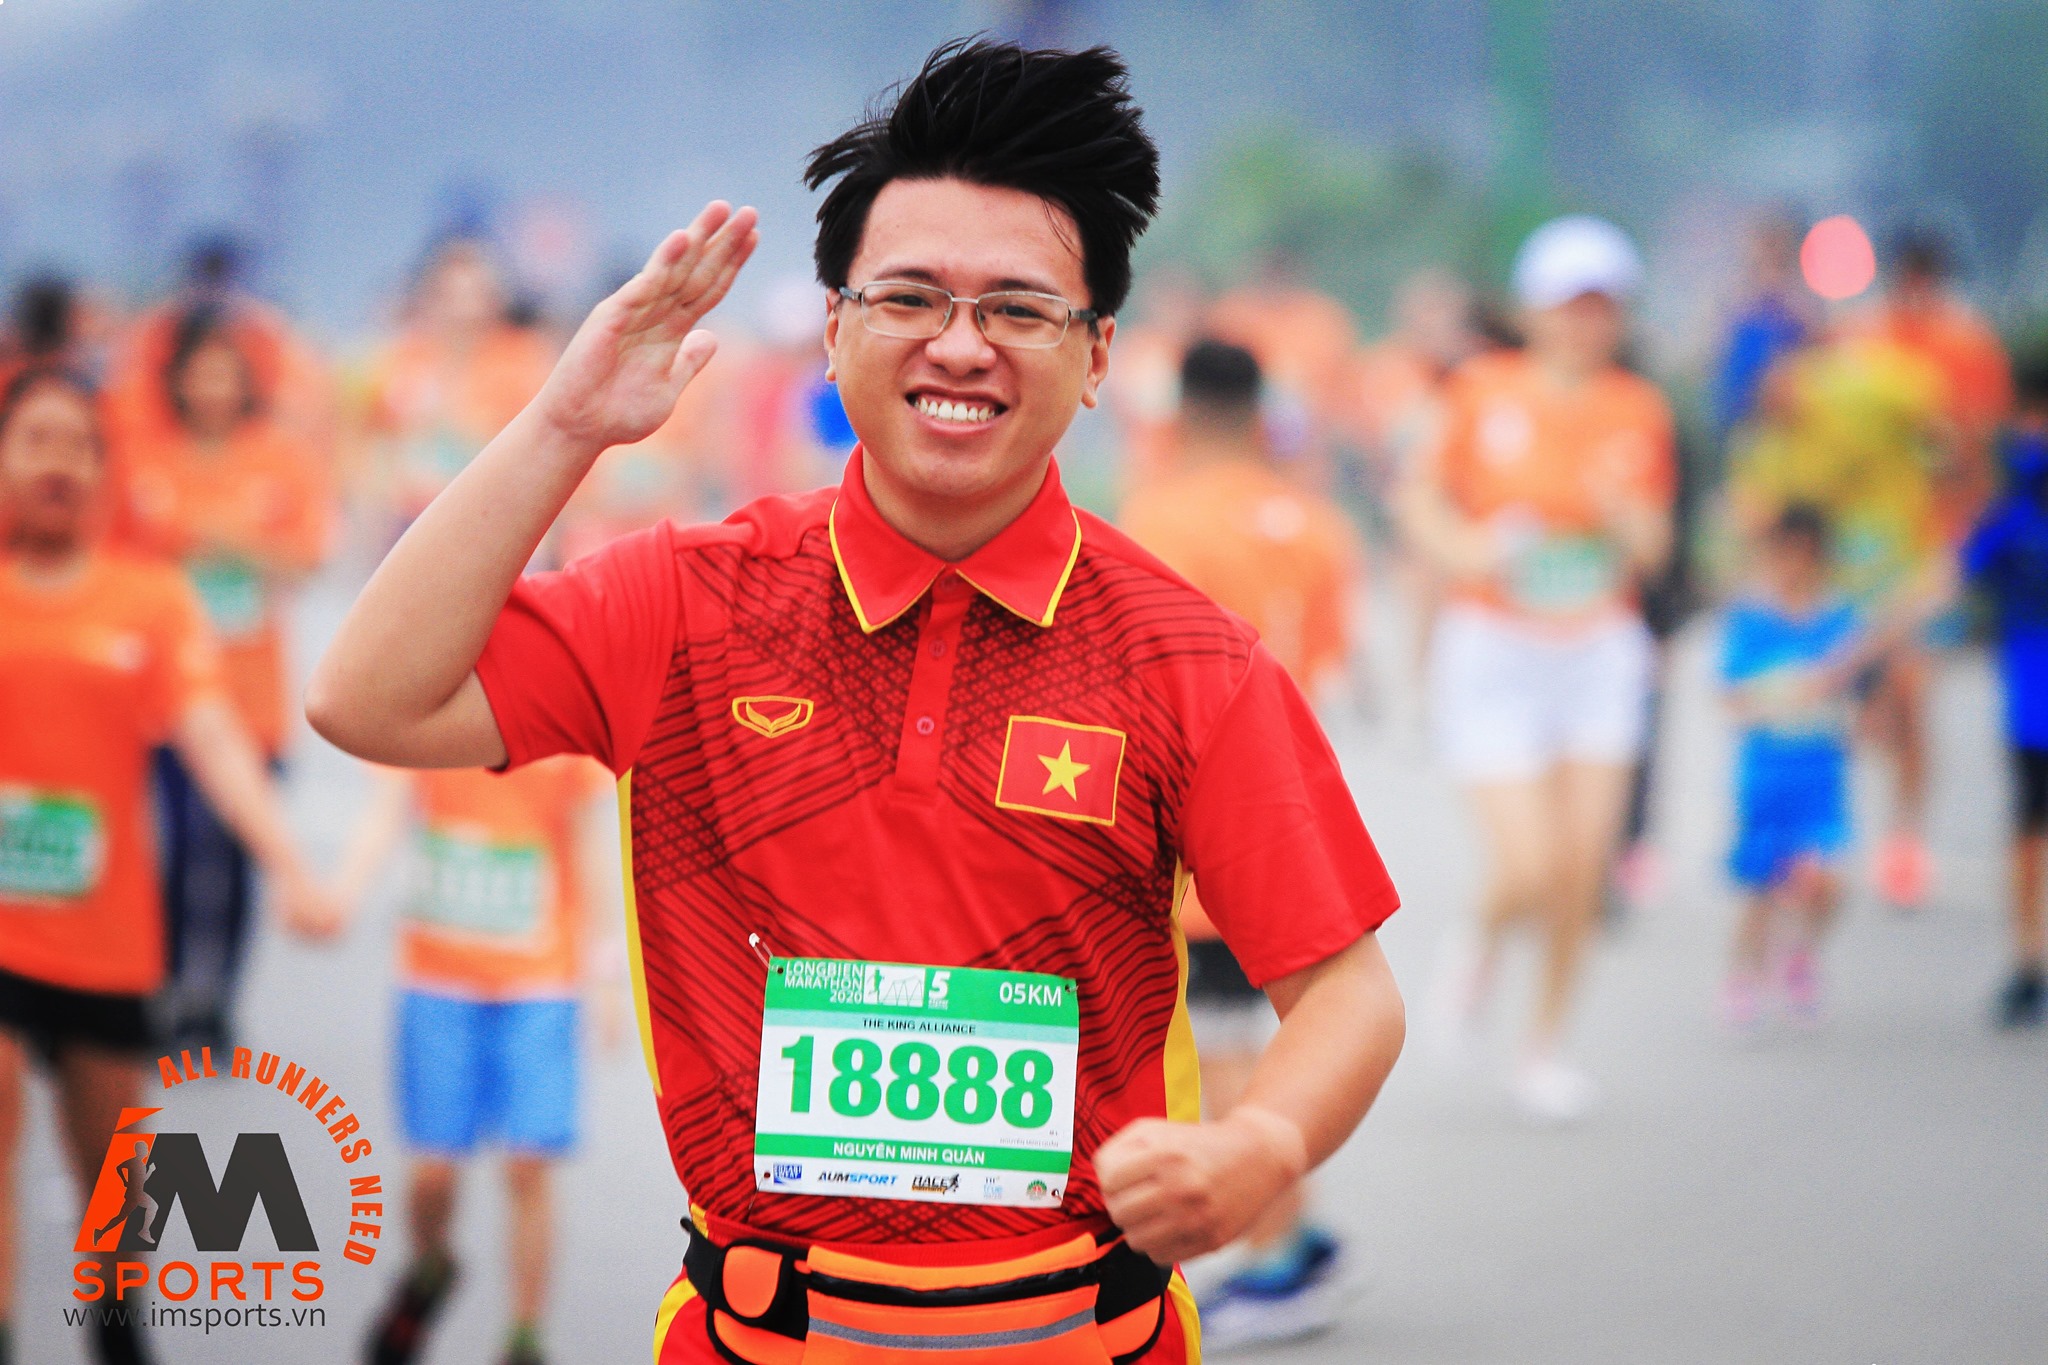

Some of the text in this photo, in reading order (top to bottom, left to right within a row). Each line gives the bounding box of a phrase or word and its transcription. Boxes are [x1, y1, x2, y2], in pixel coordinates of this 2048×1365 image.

[784, 975, 863, 991] MARATHON
[928, 970, 951, 1000] 5
[829, 989, 863, 1004] 2020
[999, 981, 1062, 1007] 05KM
[862, 1018, 976, 1035] THE KING ALLIANCE
[781, 1035, 1054, 1129] 18888
[900, 1145, 938, 1161] MINH
[941, 1147, 985, 1165] QUÂN
[818, 1170, 898, 1186] AUMSPORT
